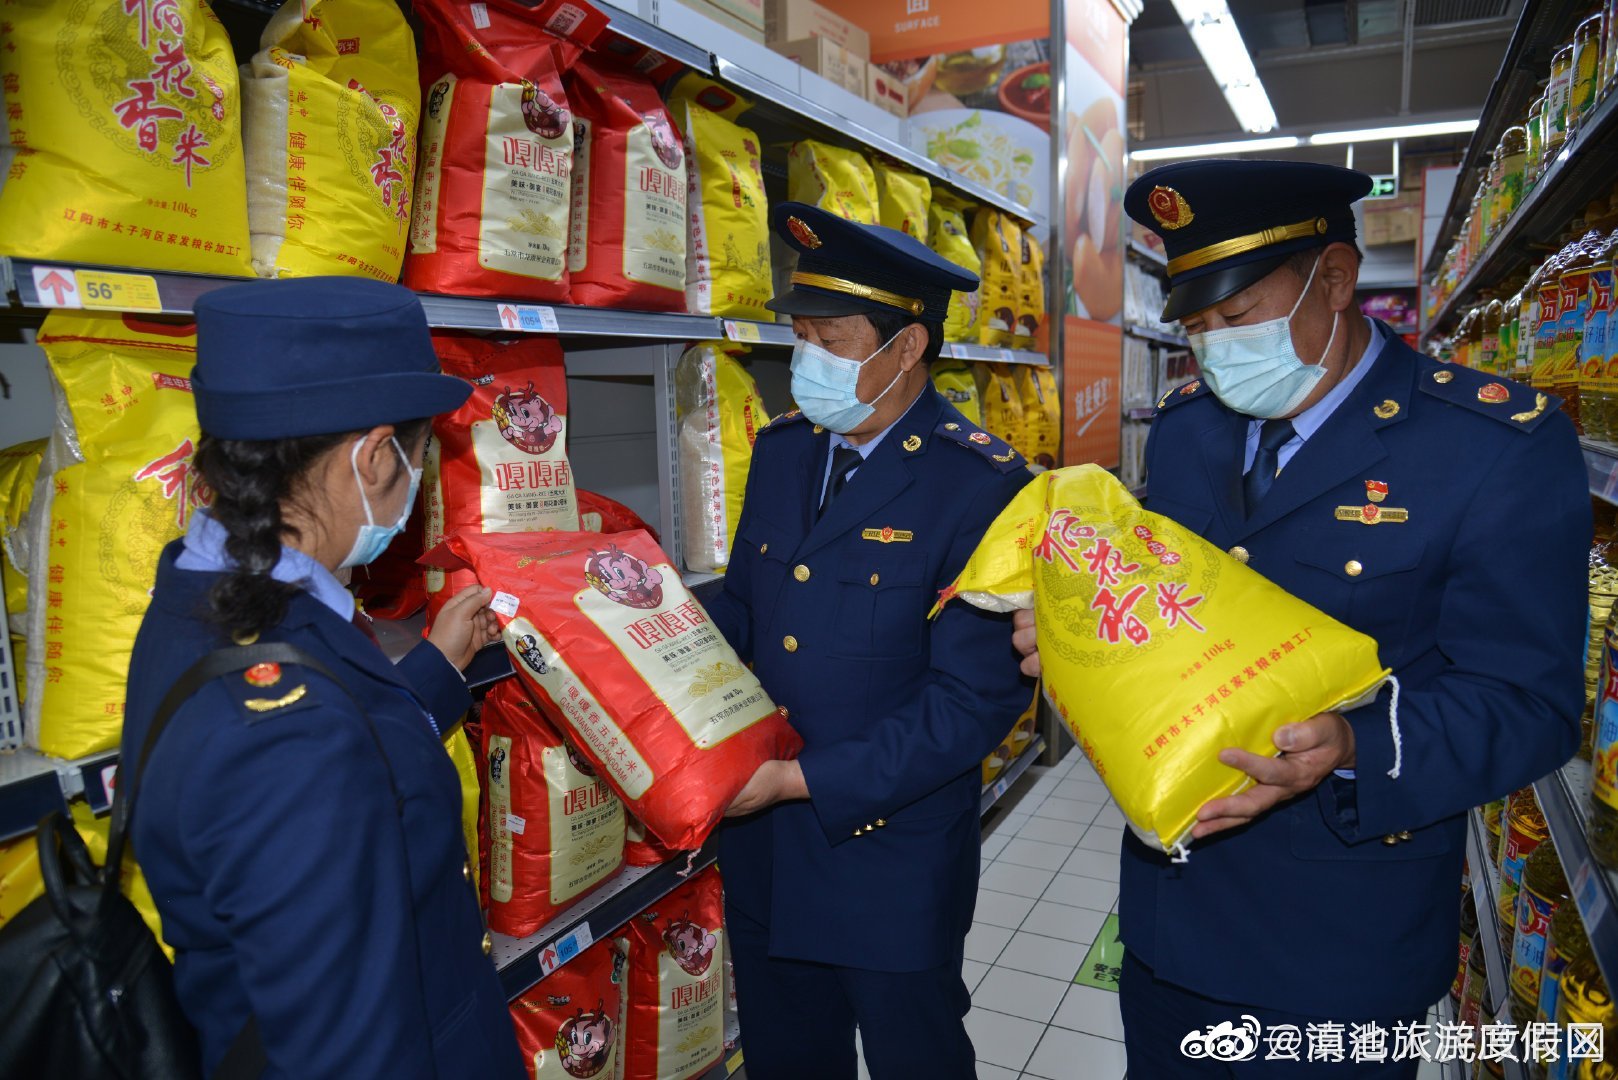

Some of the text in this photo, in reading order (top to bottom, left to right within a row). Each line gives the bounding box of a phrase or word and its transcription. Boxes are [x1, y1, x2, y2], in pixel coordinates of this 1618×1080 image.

[495, 460, 570, 491] 嘎嘎香
[1032, 508, 1207, 647] 稻花香米
[624, 599, 708, 650] 嘎嘎香
[1143, 627, 1314, 760] 辽阳市太子河区家发粮谷加工厂
